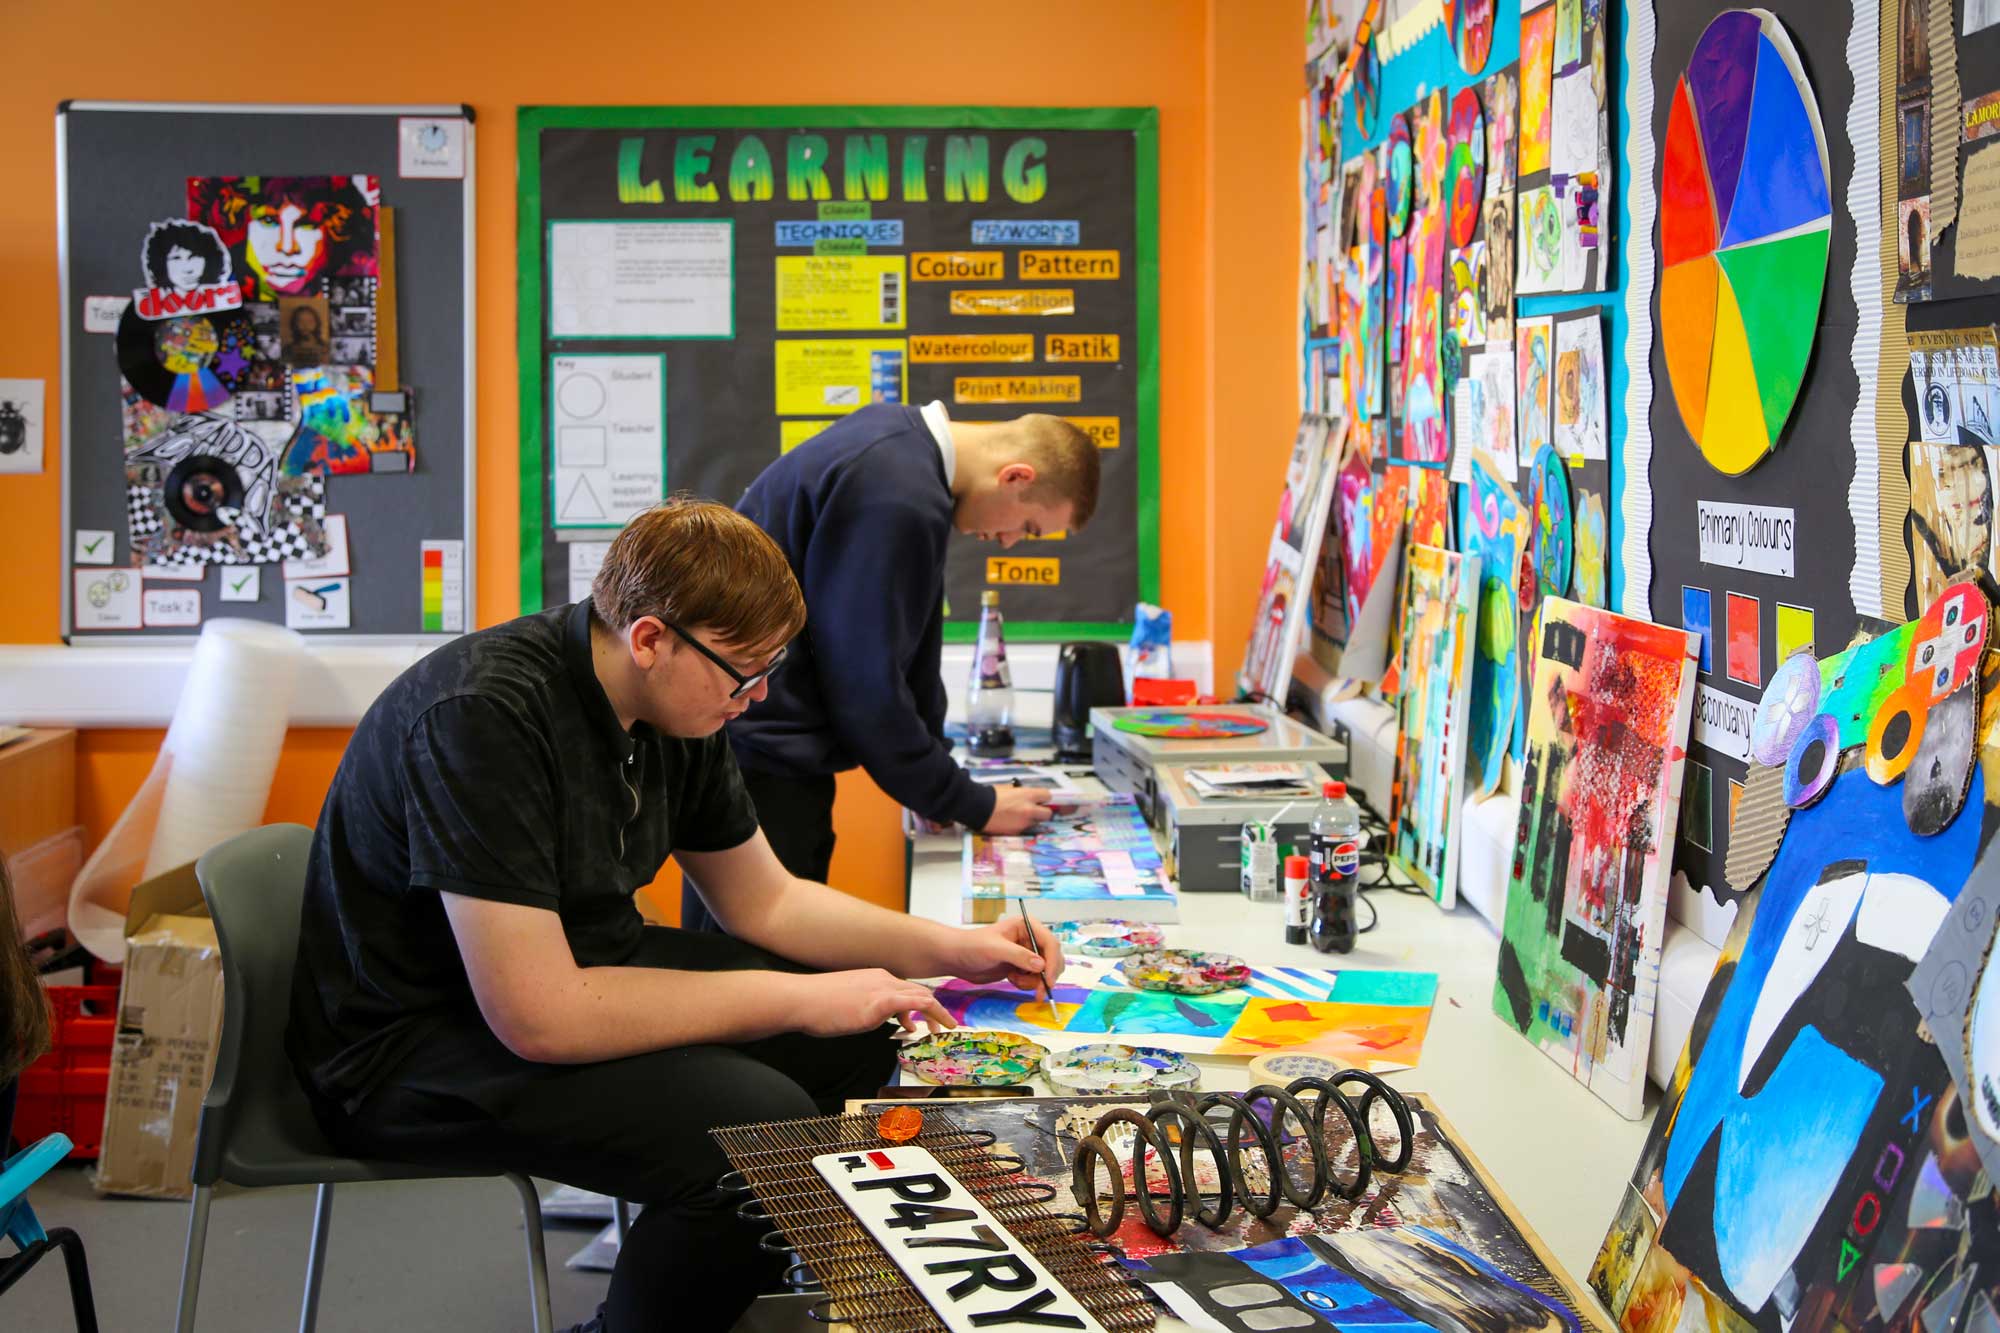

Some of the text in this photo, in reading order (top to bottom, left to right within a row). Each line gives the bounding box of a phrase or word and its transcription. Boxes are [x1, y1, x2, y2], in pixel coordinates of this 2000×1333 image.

[1965, 101, 2000, 128] LAMOR
[618, 134, 1048, 203] LEARNING
[780, 223, 900, 241] TECHNIQUES
[916, 257, 997, 277] Colour
[1024, 254, 1114, 274] Pattern
[955, 293, 1073, 312] Composition
[913, 339, 1029, 356] Watercolour
[1051, 337, 1114, 358] Batik
[1920, 334, 1960, 346] EVENING
[1963, 334, 1981, 345] SUN
[959, 378, 1076, 397] Print Making
[1701, 508, 1792, 564] Primary Colours
[993, 561, 1054, 582] Tone
[1694, 691, 1750, 758] Secondary
[1334, 855, 1358, 863] PEPS
[851, 1173, 1087, 1330] P47RY
